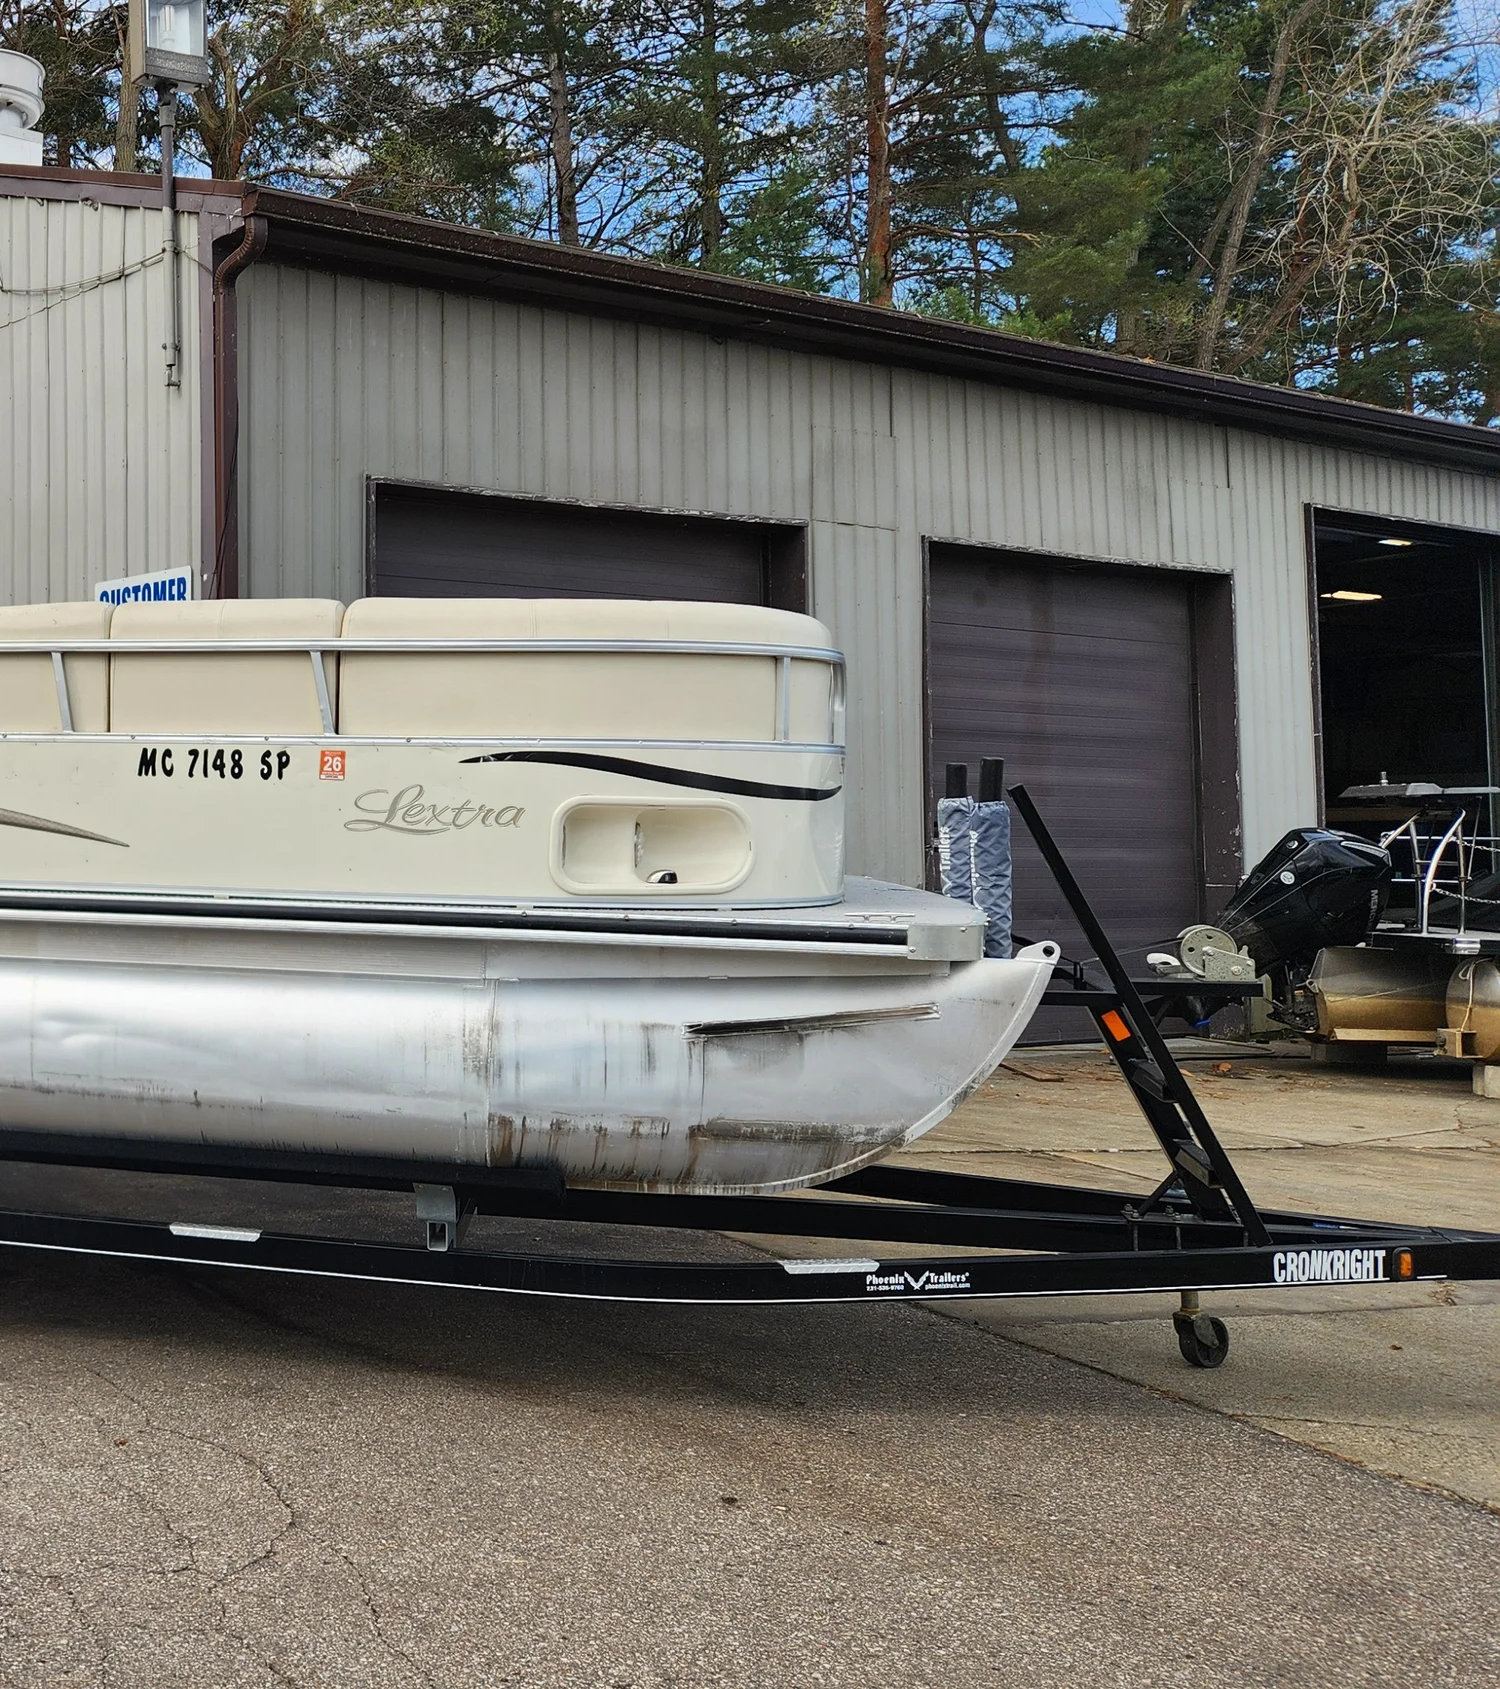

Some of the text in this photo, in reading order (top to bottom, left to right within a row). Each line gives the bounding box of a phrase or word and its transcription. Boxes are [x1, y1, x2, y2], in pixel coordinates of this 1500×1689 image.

[99, 577, 187, 606] CUSTOMER
[137, 747, 291, 780] MC 7148 SP
[323, 756, 342, 772] 26
[343, 784, 526, 836] Lextra
[866, 1273, 905, 1285] Phoenix
[1273, 1249, 1386, 1283] CRONKRIGHT
